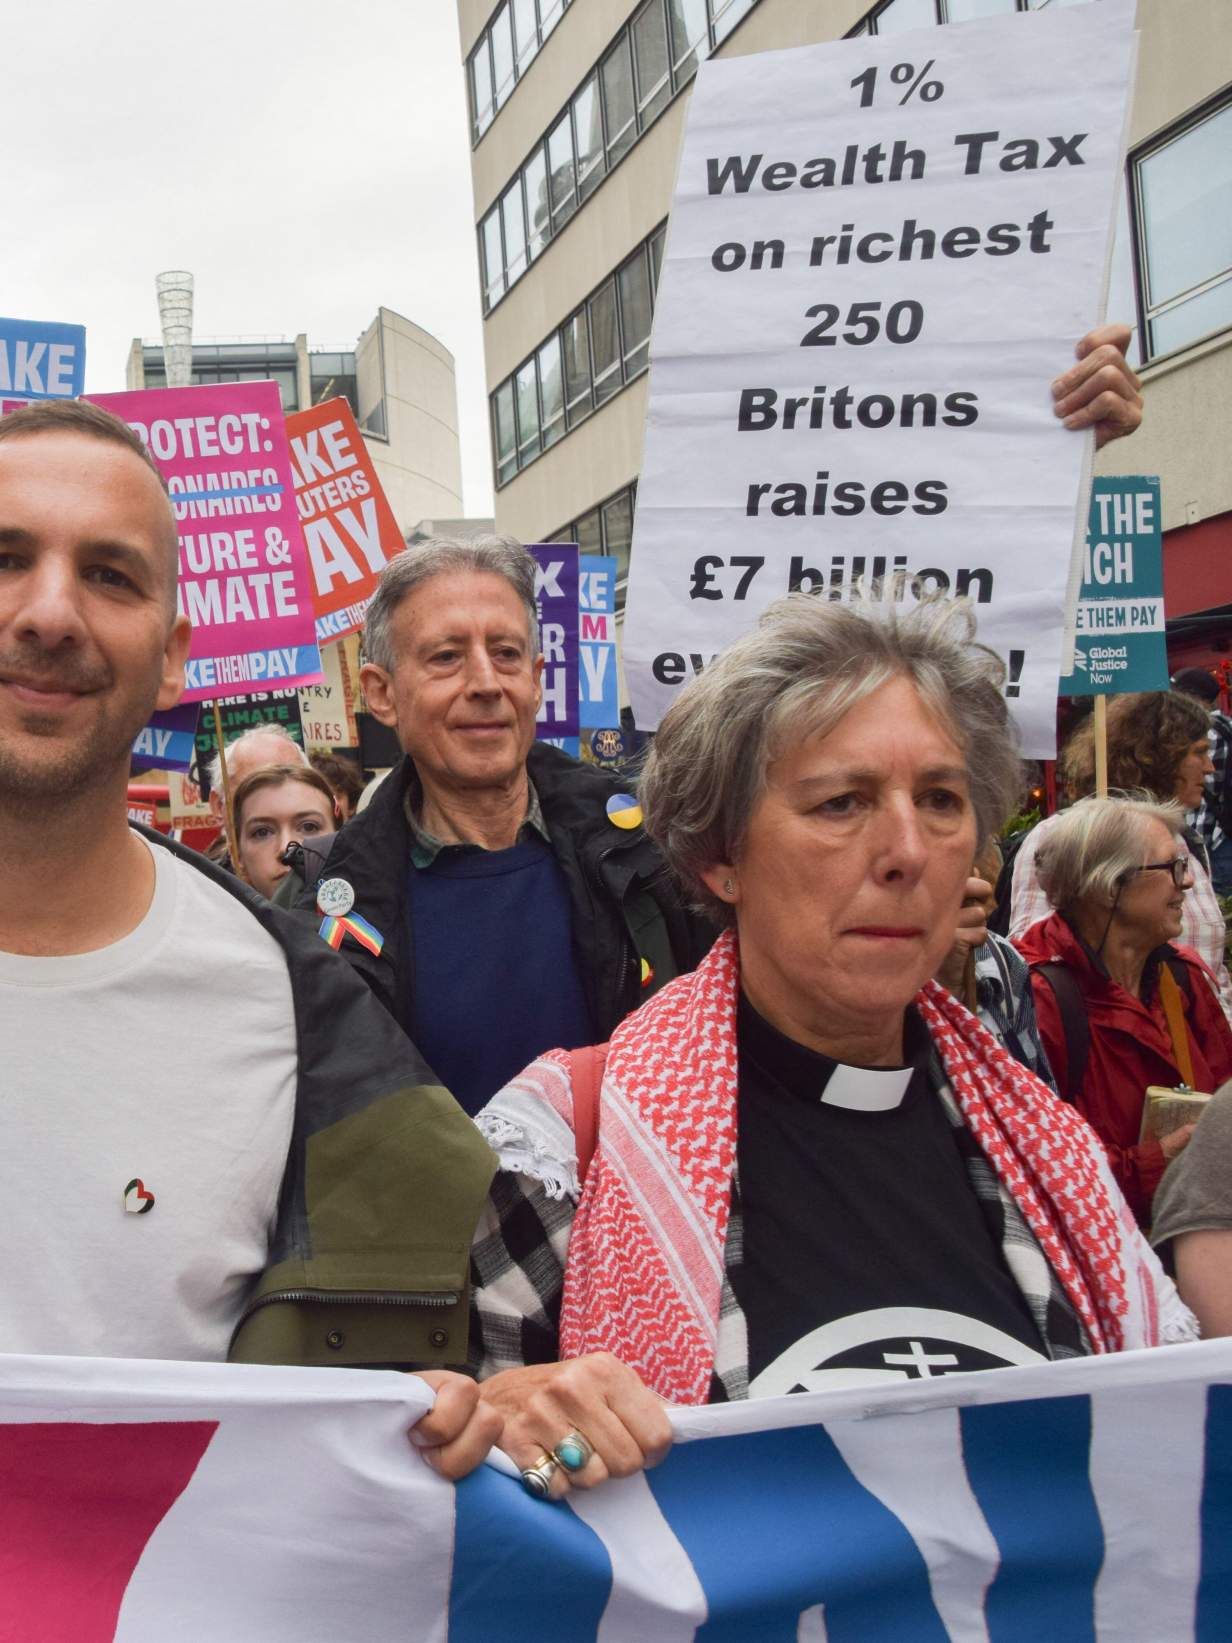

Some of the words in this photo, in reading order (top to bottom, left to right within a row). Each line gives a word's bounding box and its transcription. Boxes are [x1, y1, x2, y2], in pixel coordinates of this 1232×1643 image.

[849, 59, 945, 109] 1%
[705, 139, 928, 196] Wealth
[953, 130, 1089, 177] Tax
[711, 230, 786, 273] on
[809, 210, 1055, 268] richest
[799, 300, 924, 347] 250
[737, 387, 980, 432] Britons
[290, 419, 359, 489] KE
[295, 469, 371, 521] UTERS
[744, 471, 949, 517] raises
[1095, 492, 1154, 535] THE
[265, 526, 292, 564] &
[302, 496, 389, 597] AY
[1083, 542, 1134, 584] ICH
[177, 570, 299, 628] IMATE
[689, 555, 766, 601] £7
[788, 555, 994, 604] billion
[1087, 606, 1126, 628] THEM
[1131, 605, 1157, 626] PAY
[184, 648, 299, 689] KETHEMPAY
[1089, 646, 1128, 659] Global
[1089, 658, 1128, 671] Justice
[1090, 672, 1113, 684] Now
